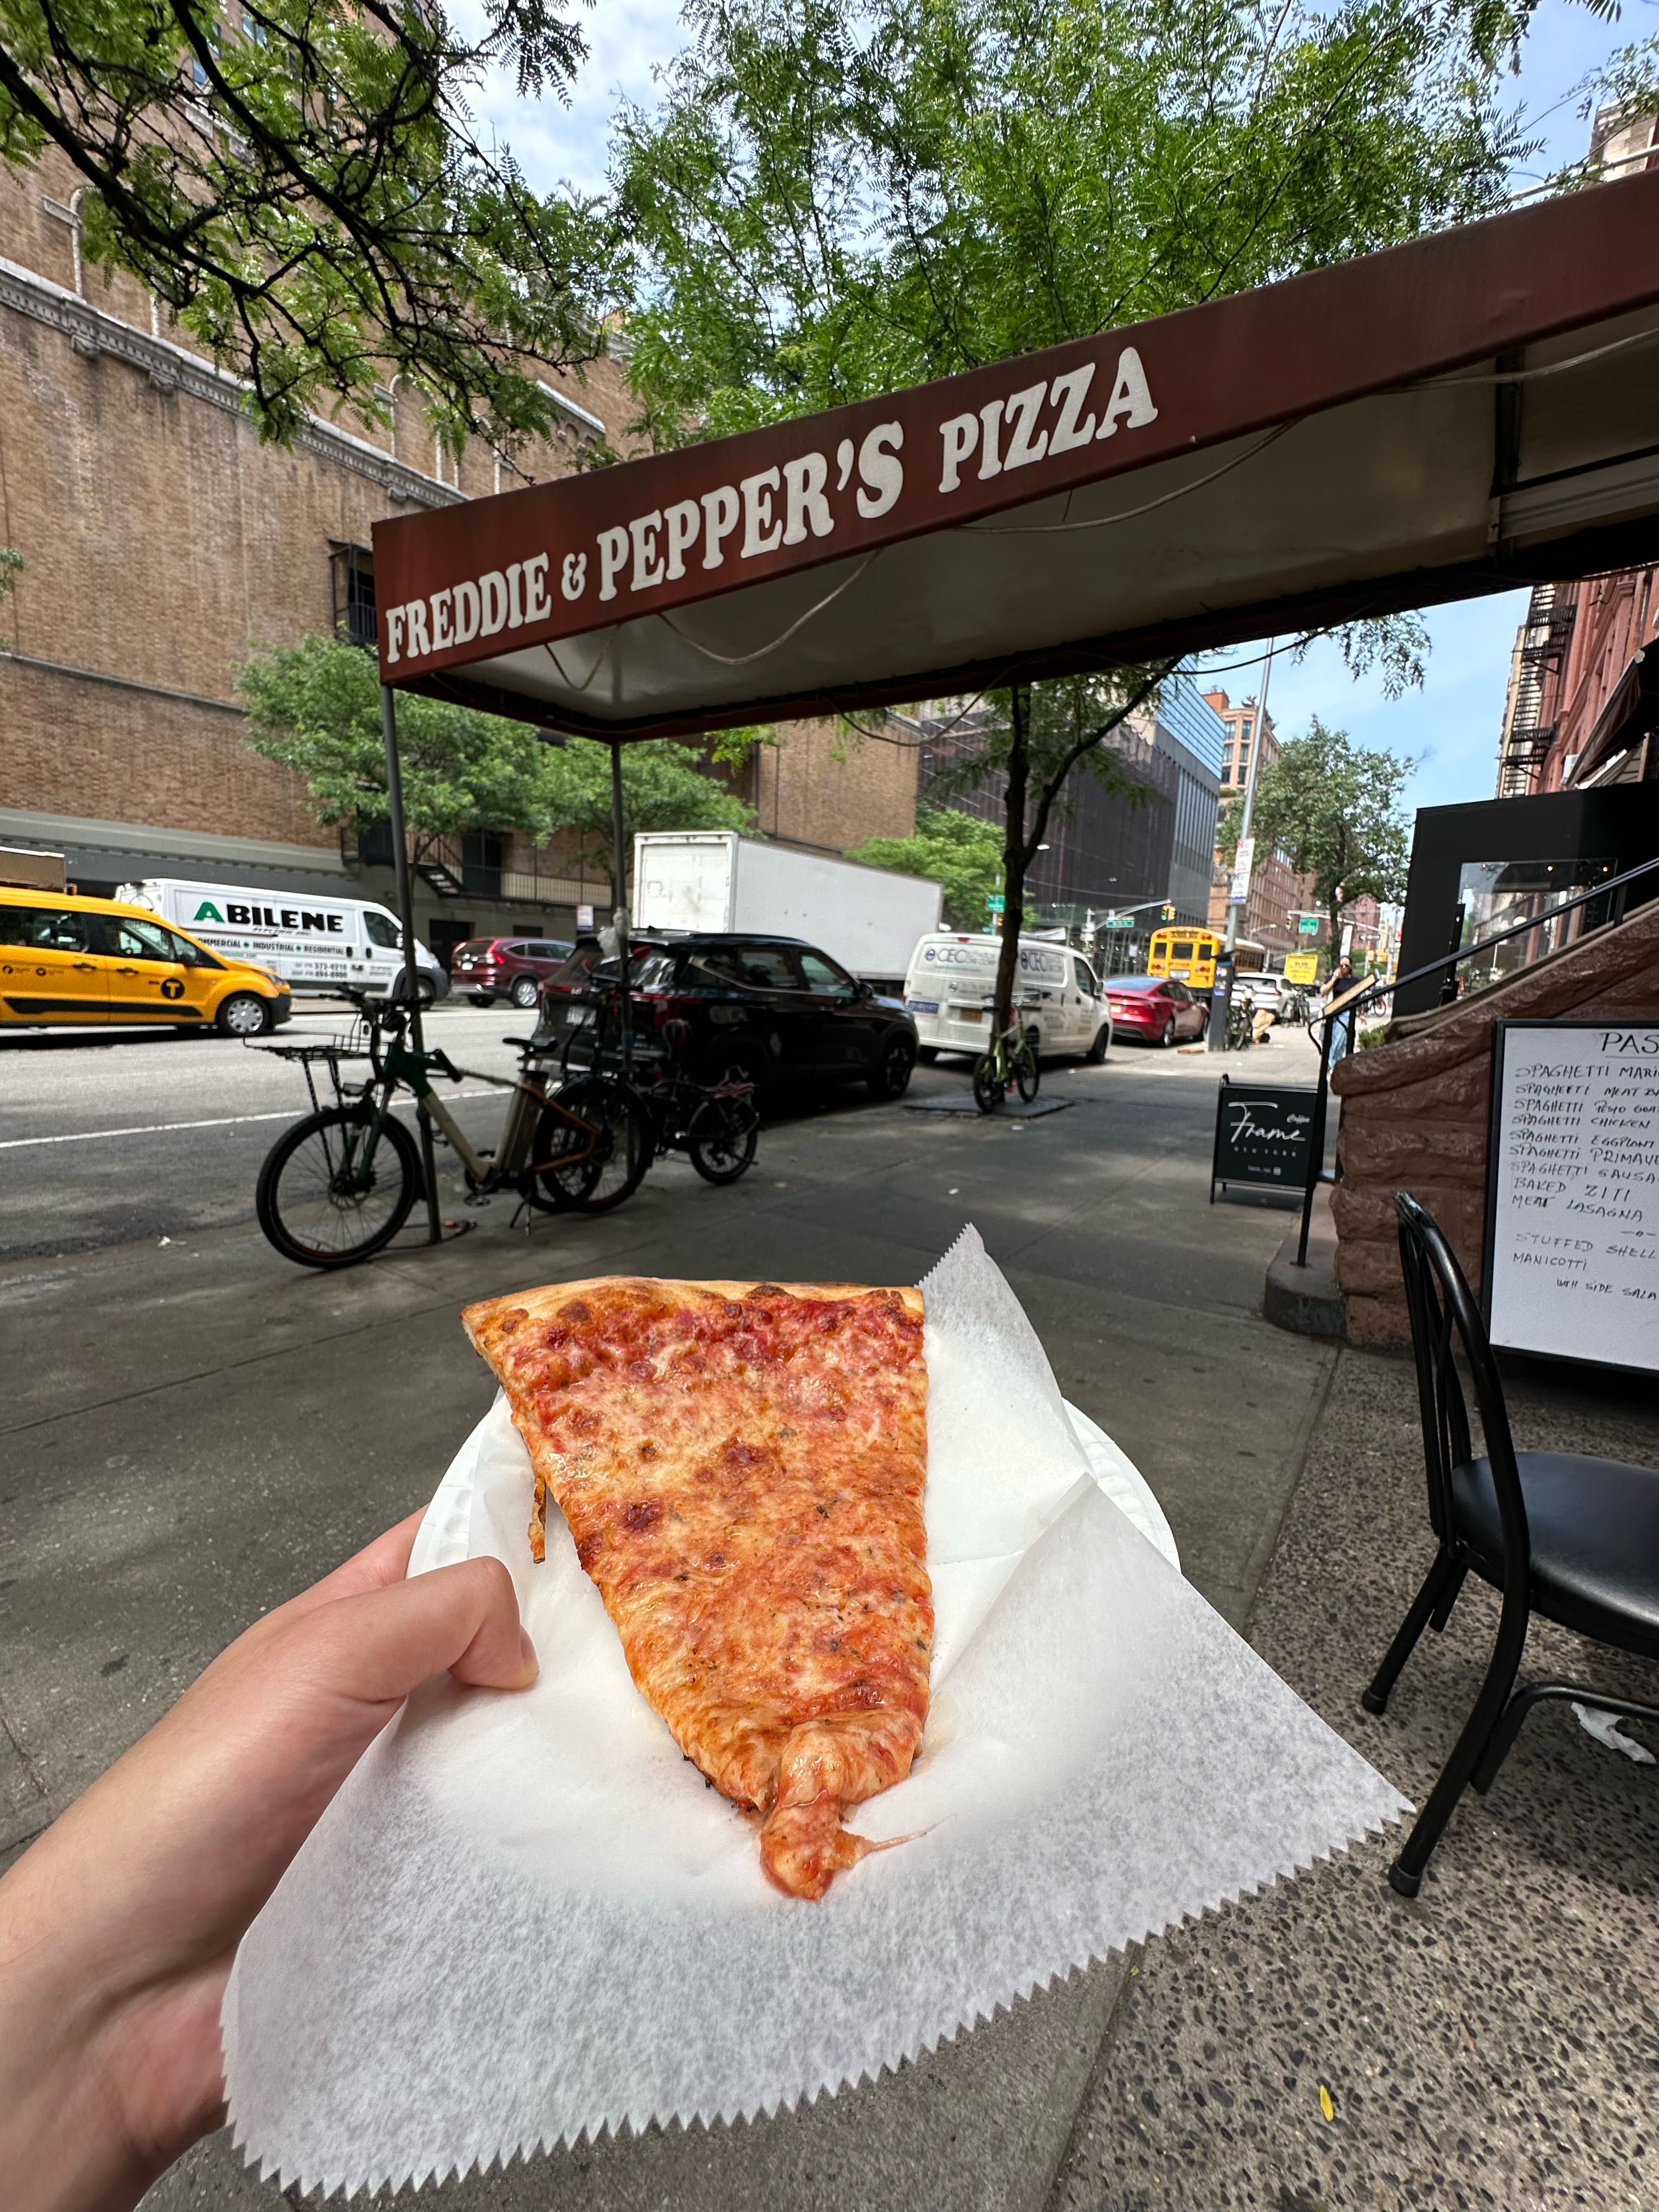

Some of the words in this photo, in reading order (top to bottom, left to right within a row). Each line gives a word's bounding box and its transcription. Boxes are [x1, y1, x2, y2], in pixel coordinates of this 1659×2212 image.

[386, 552, 552, 663] FREDDIE
[561, 552, 587, 601] &
[597, 420, 905, 601] PEPPER'S
[938, 347, 1159, 493] PIZZA
[194, 902, 344, 932] ABILENE
[304, 945, 344, 955] RESIDENTIAL
[166, 981, 180, 997] T
[1599, 1032, 1659, 1054] PAS
[1515, 1063, 1609, 1079] SPAGHETTI
[1619, 1065, 1659, 1080] MARI
[1514, 1098, 1583, 1113] SPAGHETTI
[1228, 1101, 1306, 1143] Frame
[1511, 1113, 1581, 1126] SPAGHETTI
[1590, 1116, 1650, 1128] CHICKEN
[1509, 1128, 1579, 1144] SPAGHETTI
[1509, 1142, 1581, 1160] SPAGHETTI
[1510, 1160, 1587, 1176] SPAGHETTI
[1514, 1177, 1566, 1193] BAKED
[1584, 1184, 1630, 1203] ZITI
[1513, 1194, 1555, 1208] MEAT
[1567, 1199, 1643, 1222] LASAGNA
[1516, 1232, 1593, 1252] STUFFED
[1605, 1244, 1657, 1259] SHELL
[1513, 1252, 1587, 1272] MANICOTTI
[1585, 1282, 1614, 1294] SIDE
